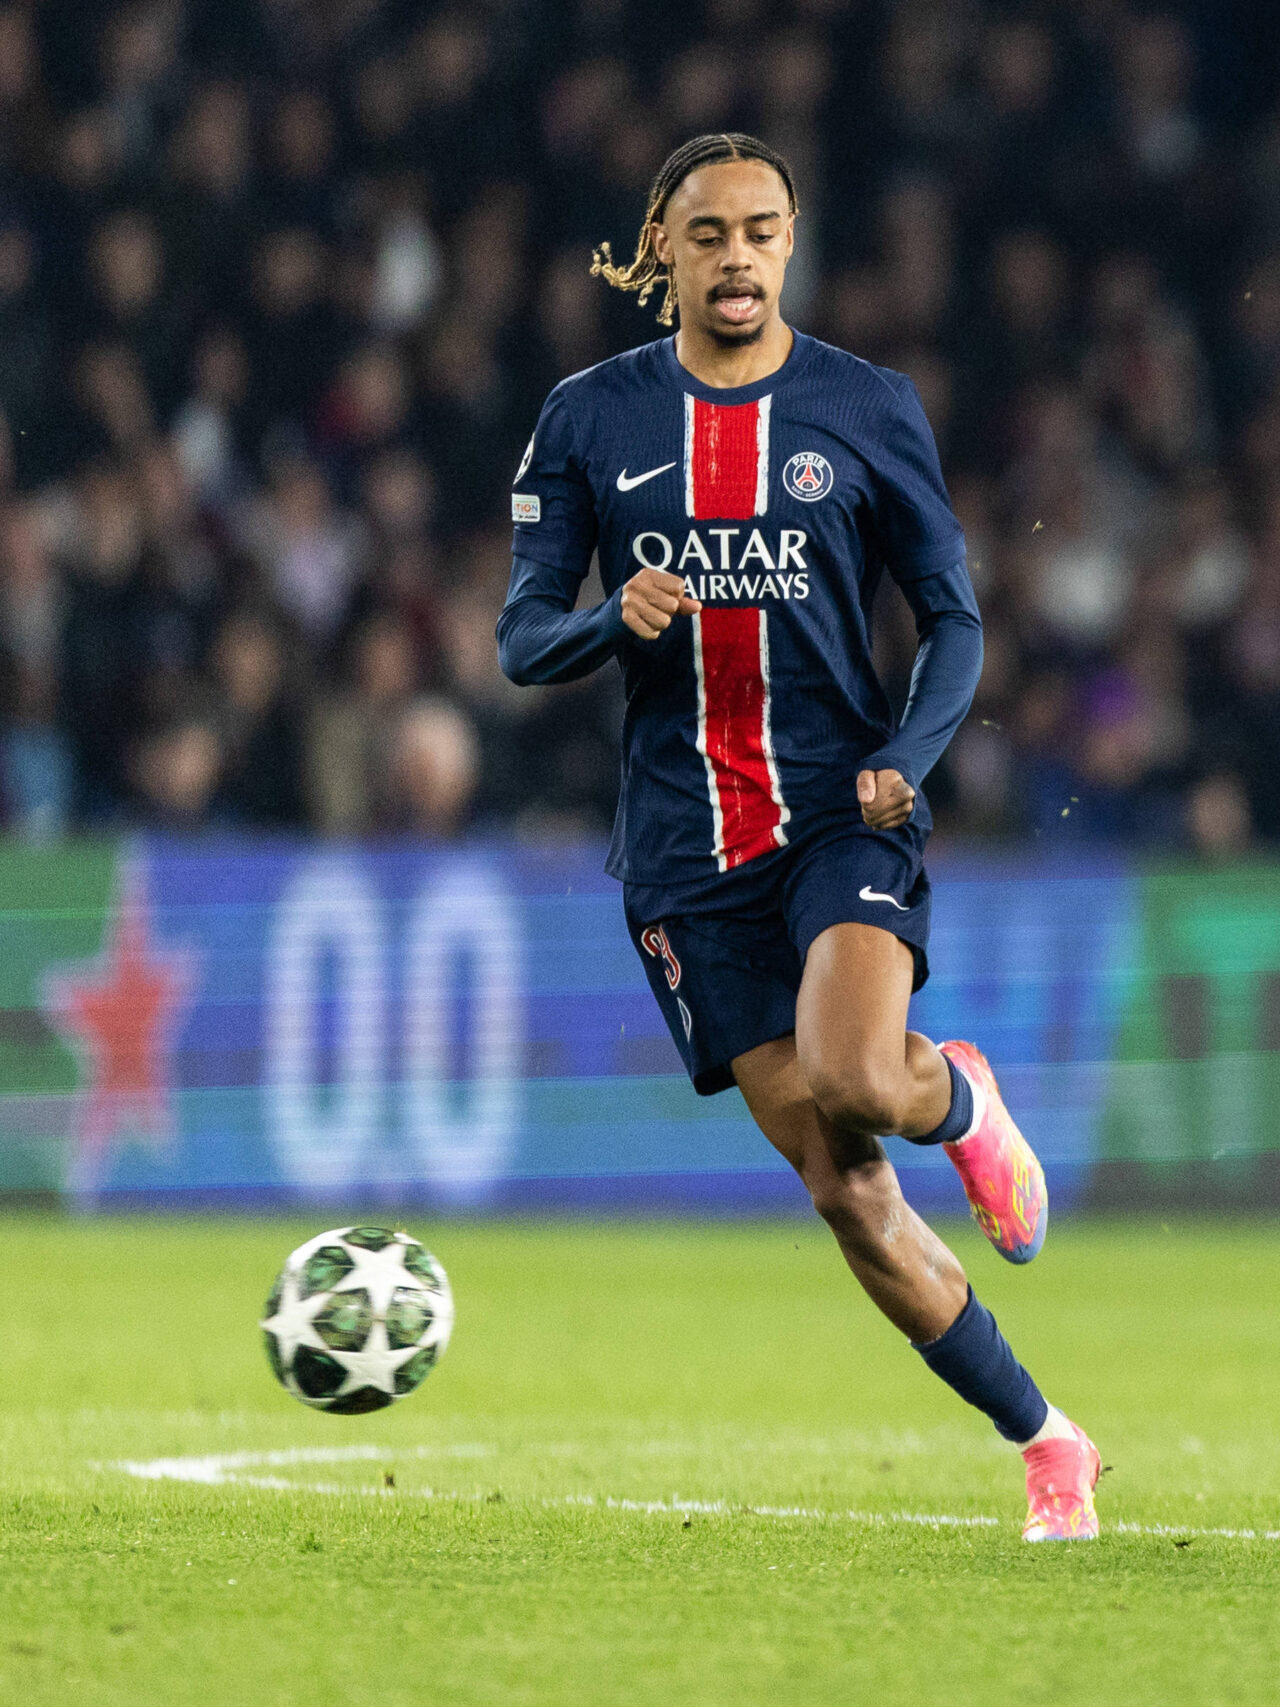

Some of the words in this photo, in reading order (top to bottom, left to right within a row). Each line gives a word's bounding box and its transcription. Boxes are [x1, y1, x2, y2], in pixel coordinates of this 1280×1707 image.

[792, 454, 826, 469] PARIS
[632, 528, 808, 573] QATAR
[684, 573, 810, 600] AIRWAYS
